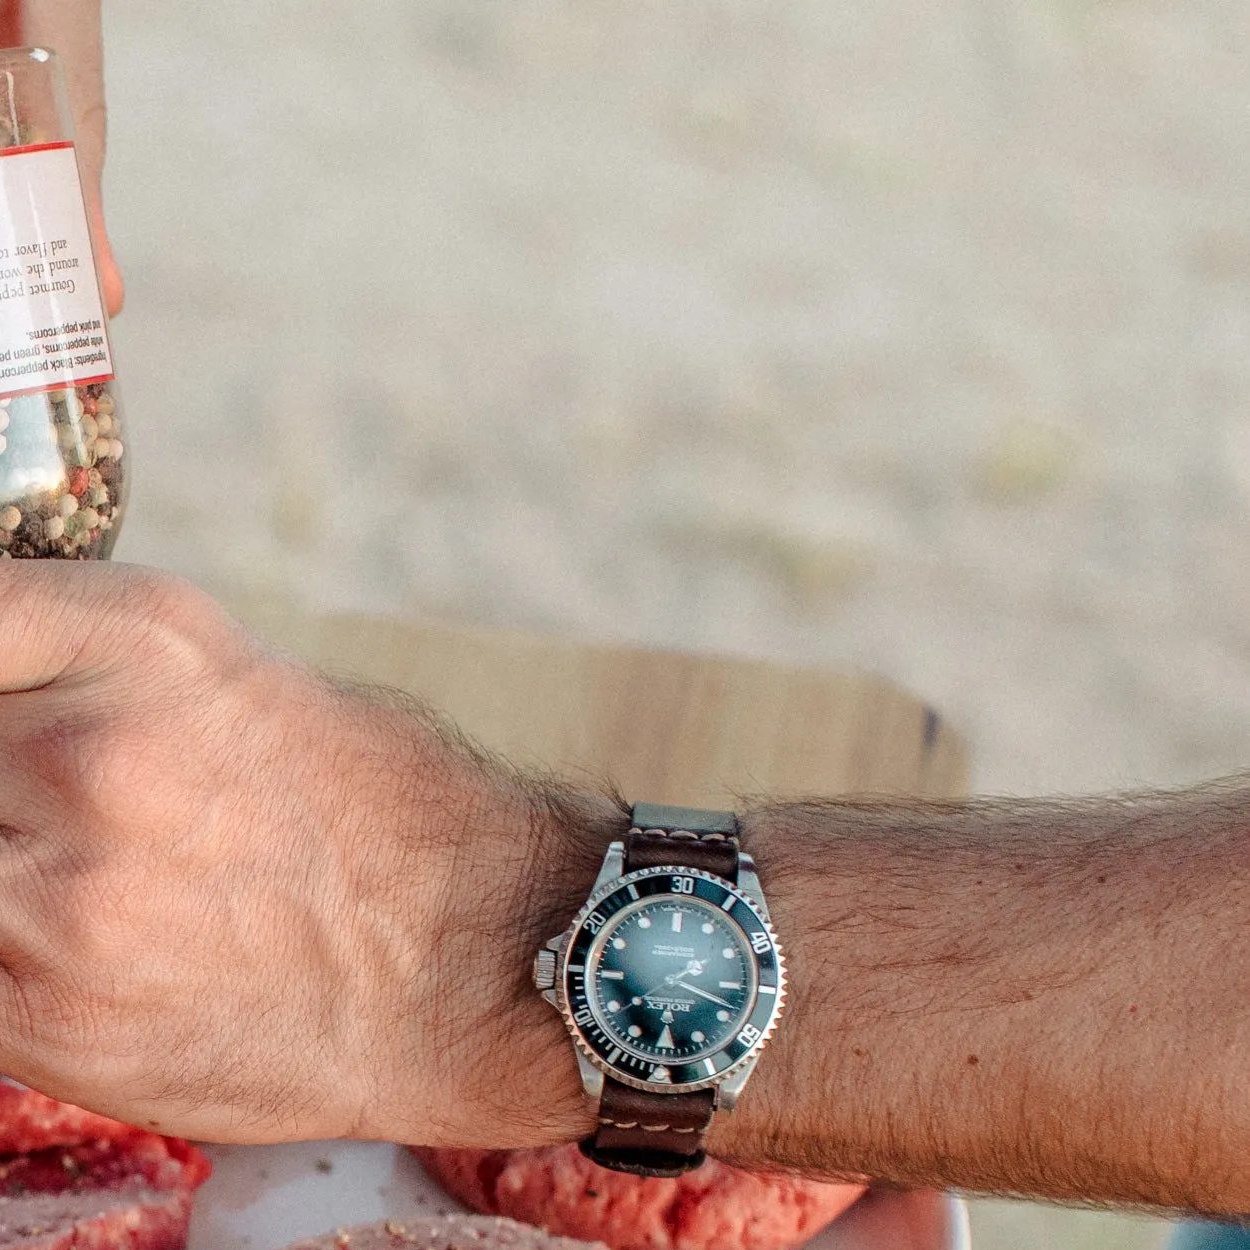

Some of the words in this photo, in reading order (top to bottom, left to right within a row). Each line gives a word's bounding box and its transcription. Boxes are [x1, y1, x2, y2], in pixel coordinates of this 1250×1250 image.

[14, 241, 47, 259] flavor
[51, 239, 67, 252] and
[27, 263, 44, 278] the
[49, 257, 79, 277] around
[29, 279, 76, 294] Gourmet
[25, 322, 79, 340] peppercorns.
[14, 344, 41, 361] green
[42, 338, 90, 354] peppercorns,
[49, 357, 74, 372] Black
[670, 876, 695, 895] 30
[582, 911, 607, 935] 20
[750, 931, 771, 954] 40
[647, 1001, 691, 1012] ROLEX
[573, 1010, 593, 1027] 10
[737, 1023, 761, 1047] 50
